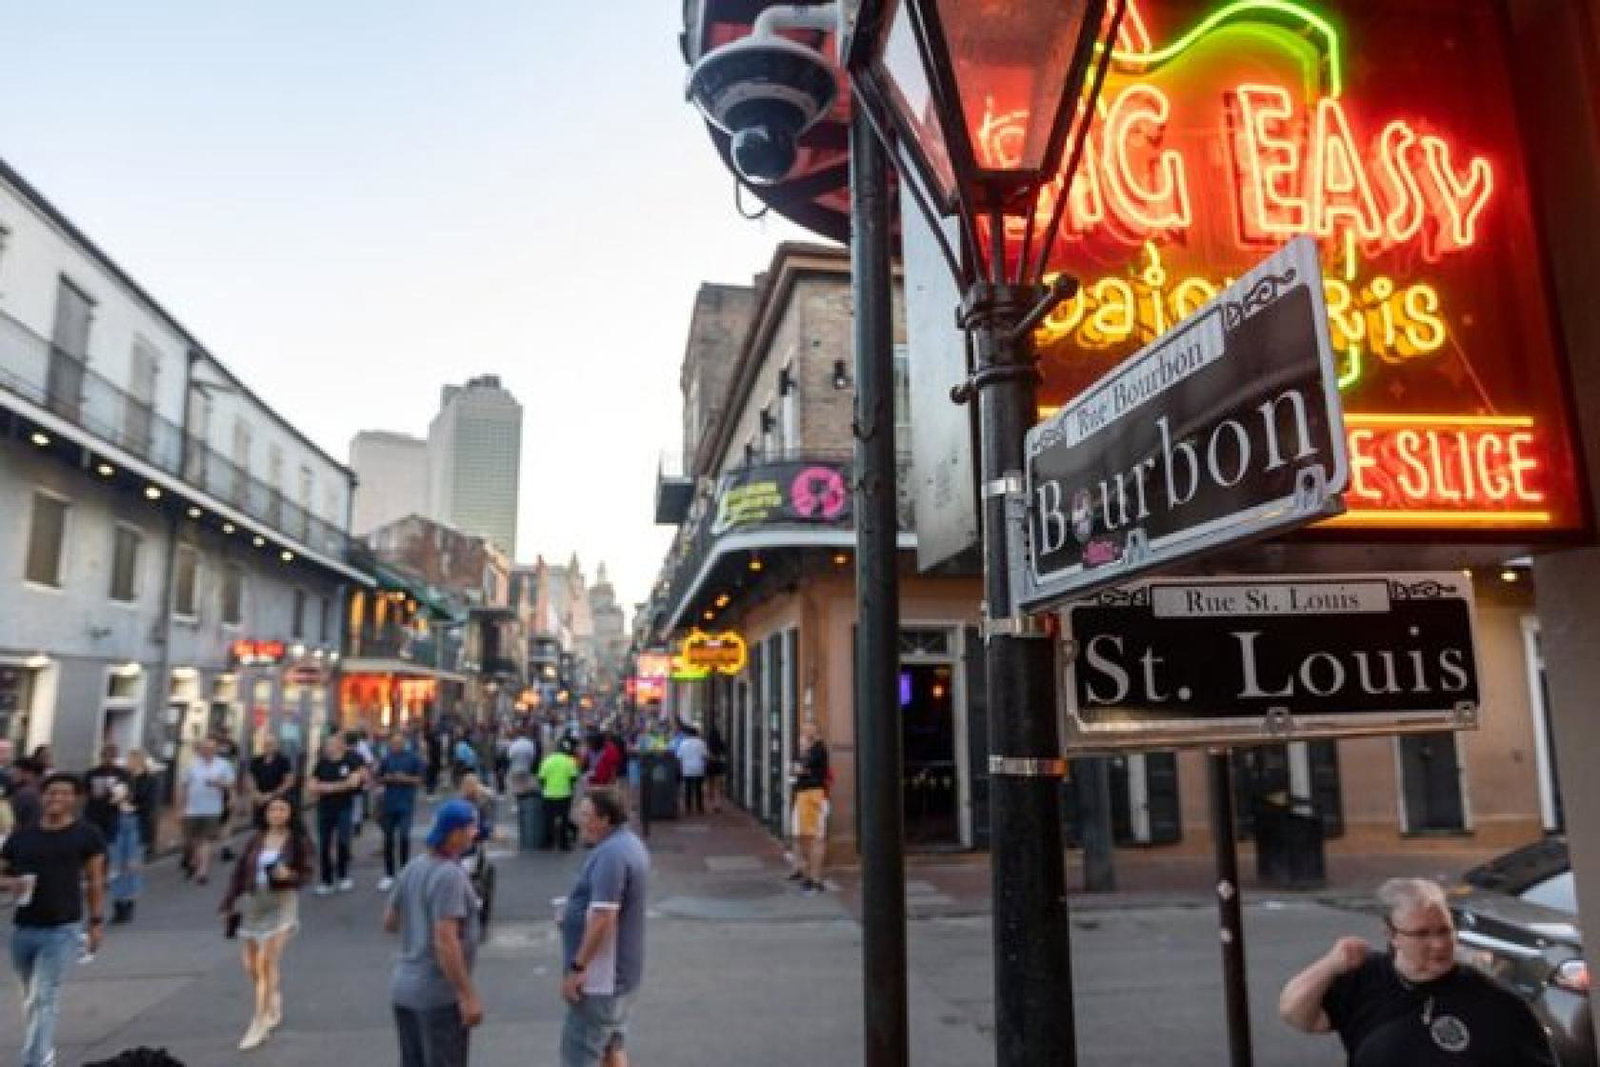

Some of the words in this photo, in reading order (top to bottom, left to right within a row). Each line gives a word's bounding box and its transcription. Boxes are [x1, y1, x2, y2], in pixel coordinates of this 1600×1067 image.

[1238, 84, 1493, 245] EASY
[1113, 344, 1204, 415] Bourbon
[1036, 387, 1318, 556] Burbon
[1185, 588, 1236, 614] Rue
[1244, 588, 1280, 612] St.
[1289, 586, 1360, 611] Louis
[1085, 634, 1193, 705] St.
[1229, 627, 1468, 699] Louis
